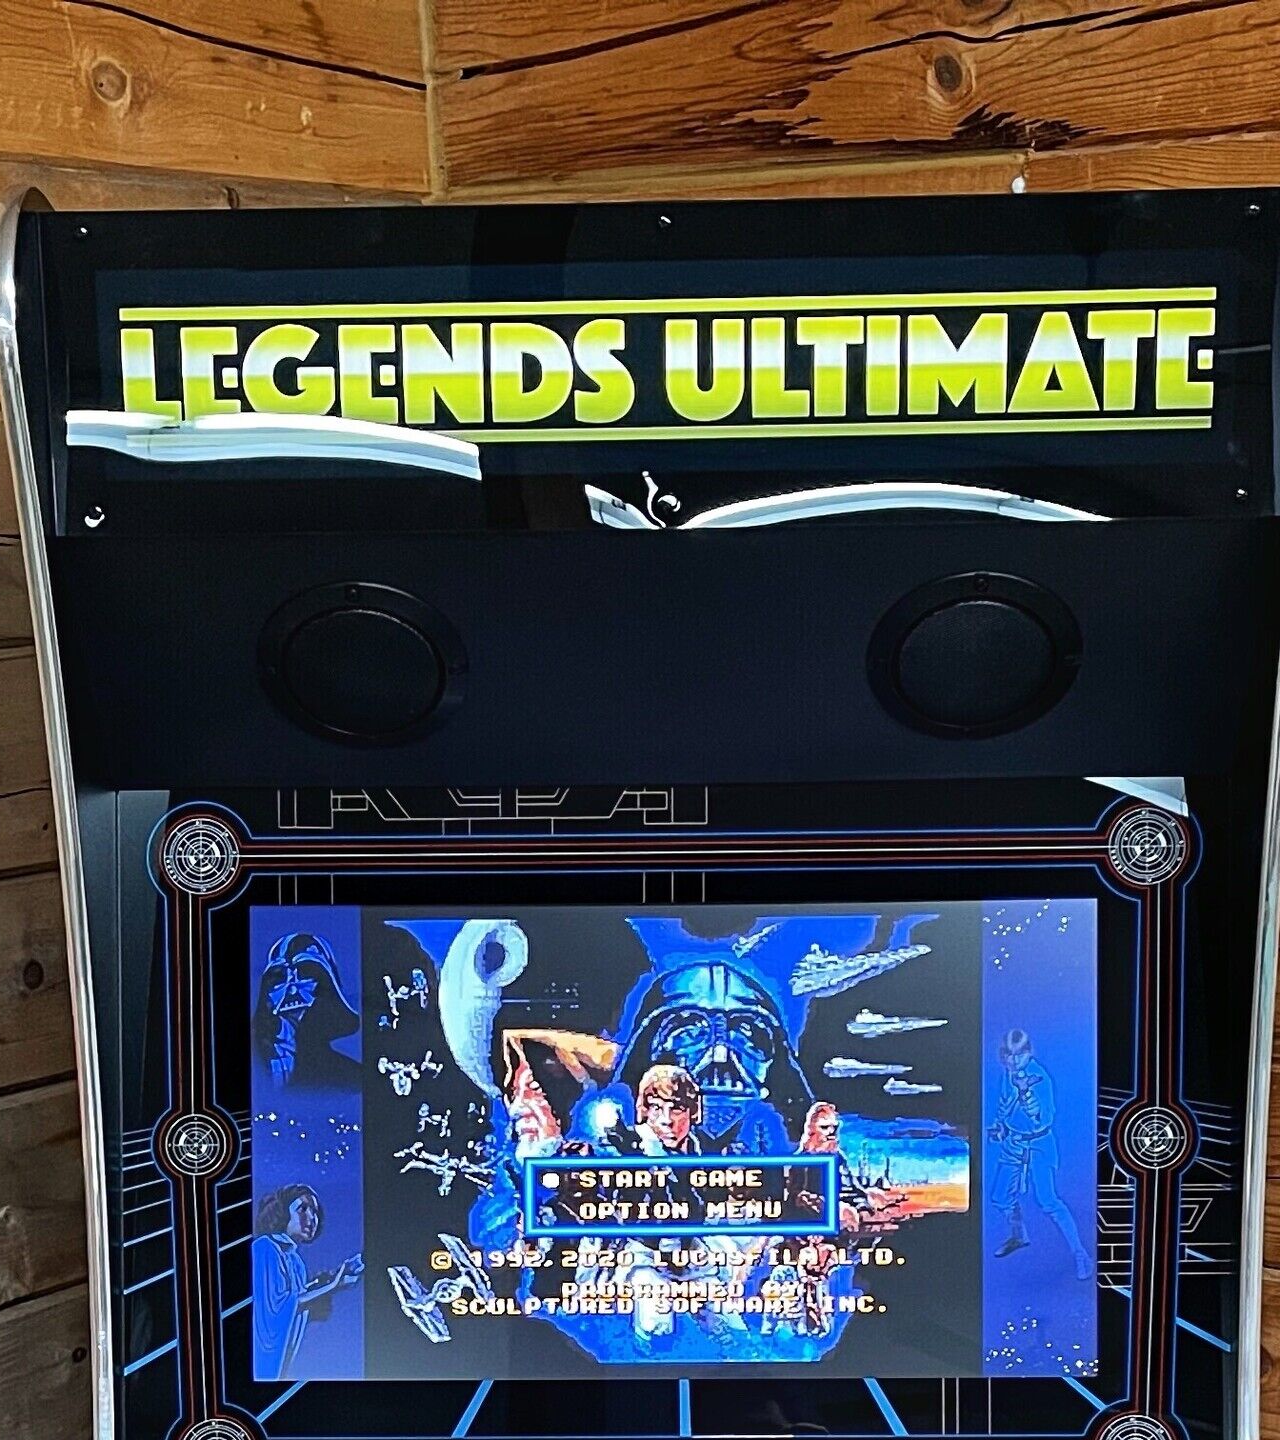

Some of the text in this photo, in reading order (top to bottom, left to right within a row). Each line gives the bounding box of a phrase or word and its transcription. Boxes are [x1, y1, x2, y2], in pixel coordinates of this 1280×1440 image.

[121, 308, 1214, 425] LEGENDS ULTIMATE
[578, 1169, 763, 1189] START GAME
[578, 1200, 783, 1220] OPTION MENU
[653, 1248, 819, 1267] LUCASFILM
[837, 1248, 906, 1266] LTD.
[561, 1281, 744, 1299] PROGRAMMED
[451, 1296, 887, 1315] SCULPTURED SOFTWARE INC.
